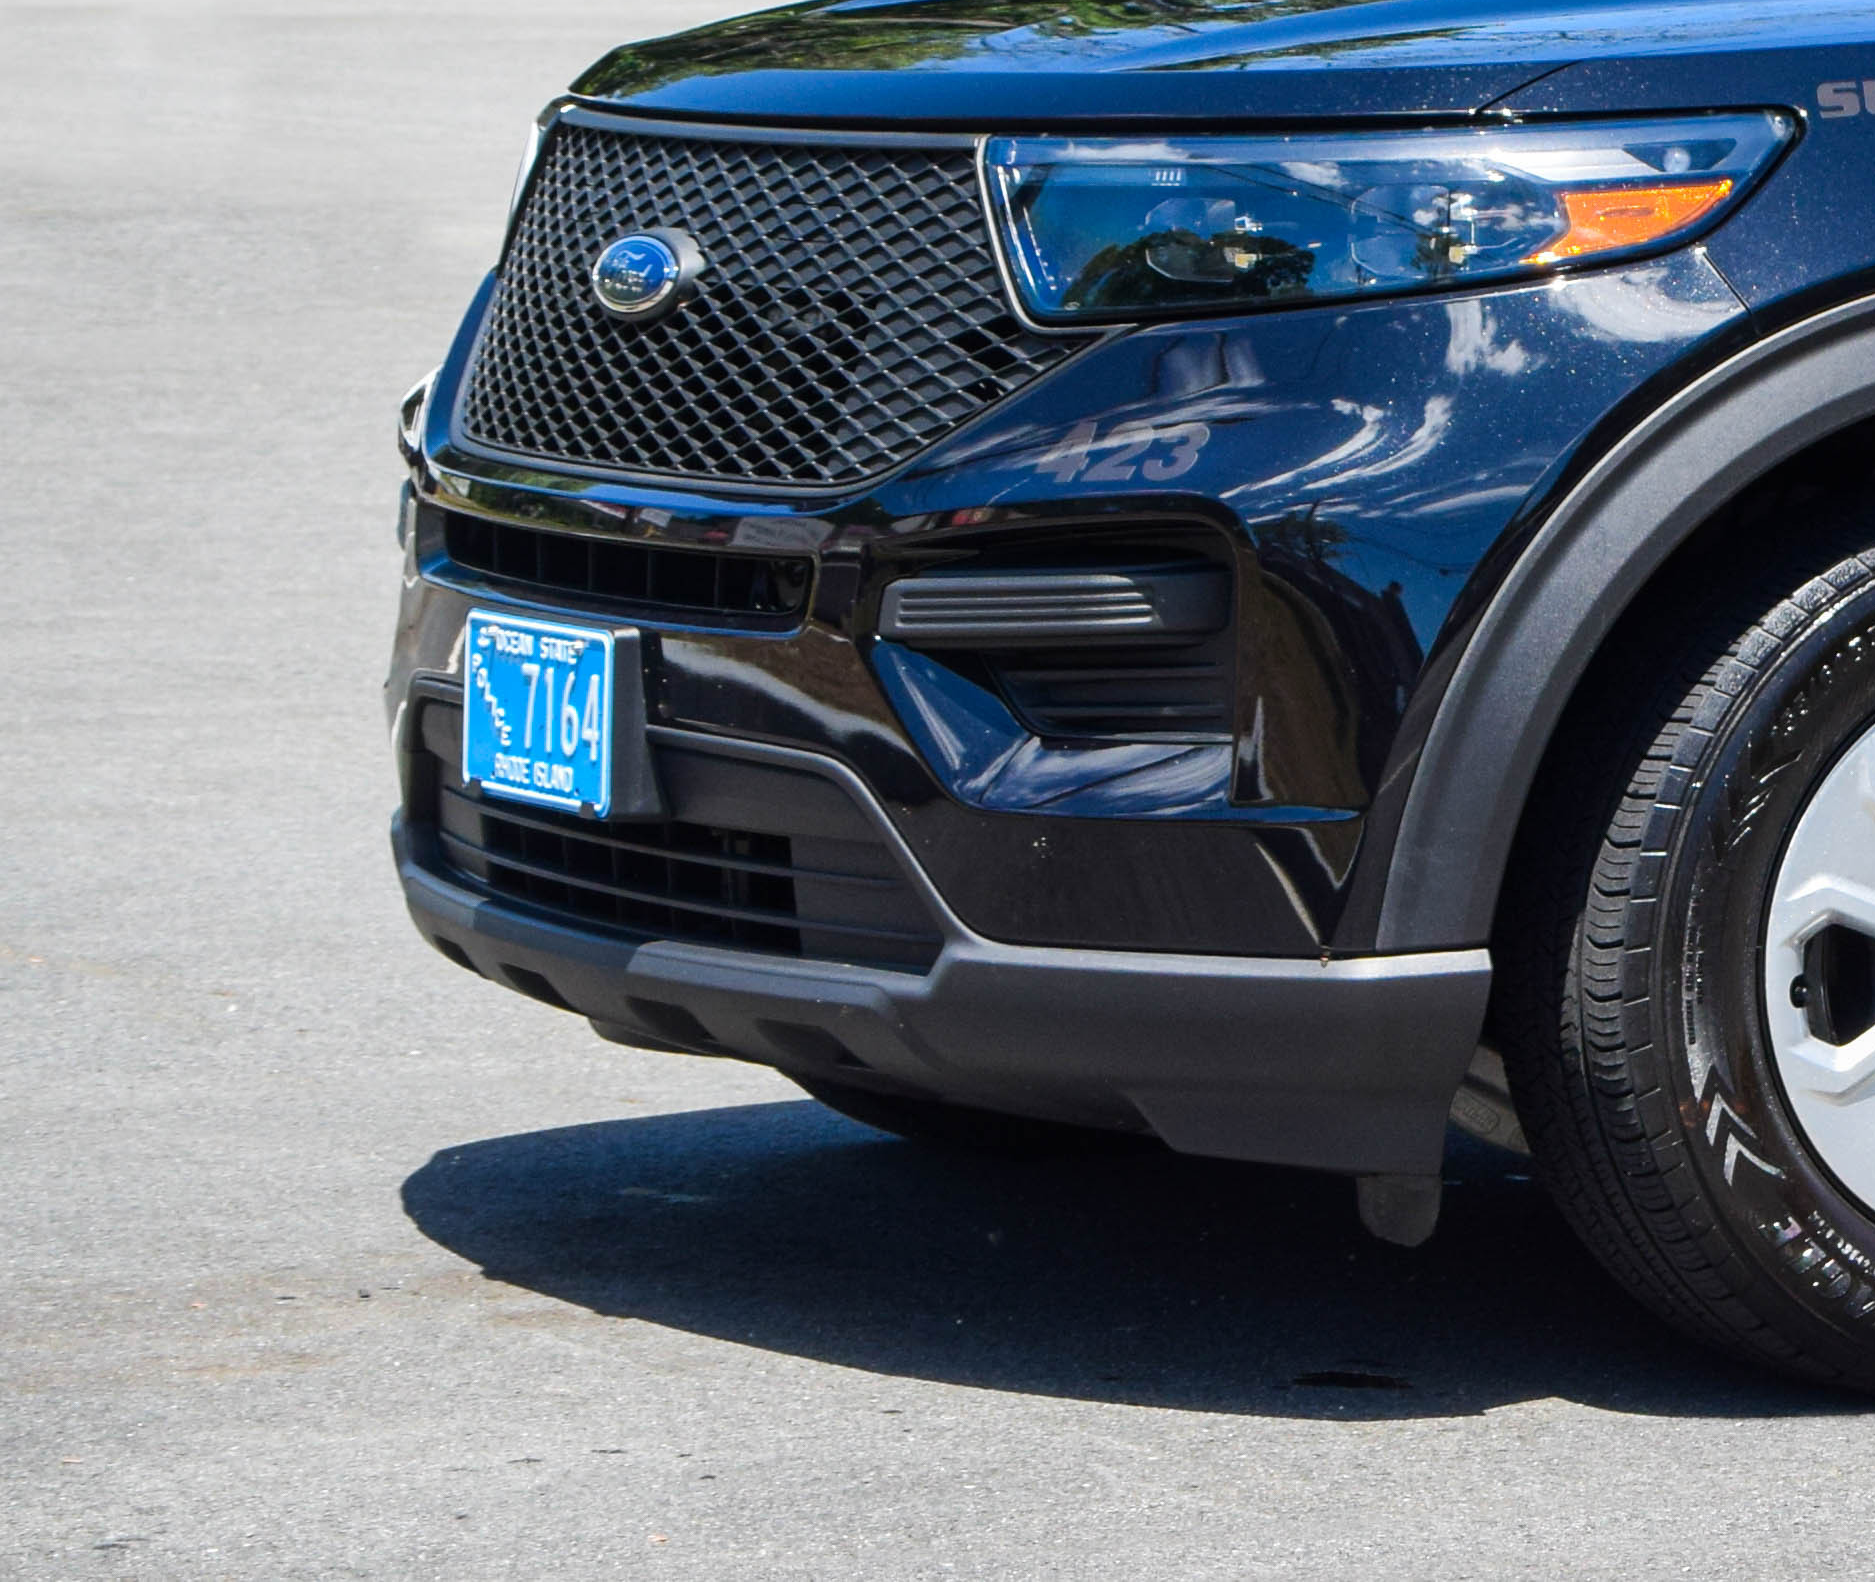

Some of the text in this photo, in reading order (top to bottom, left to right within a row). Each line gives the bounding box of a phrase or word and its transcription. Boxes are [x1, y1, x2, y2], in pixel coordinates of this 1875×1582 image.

[1035, 420, 1212, 484] 423
[540, 636, 578, 665] STATE
[472, 653, 512, 746] POLICE
[521, 662, 600, 762] 7164
[493, 752, 574, 792] RHODE ISLAND
